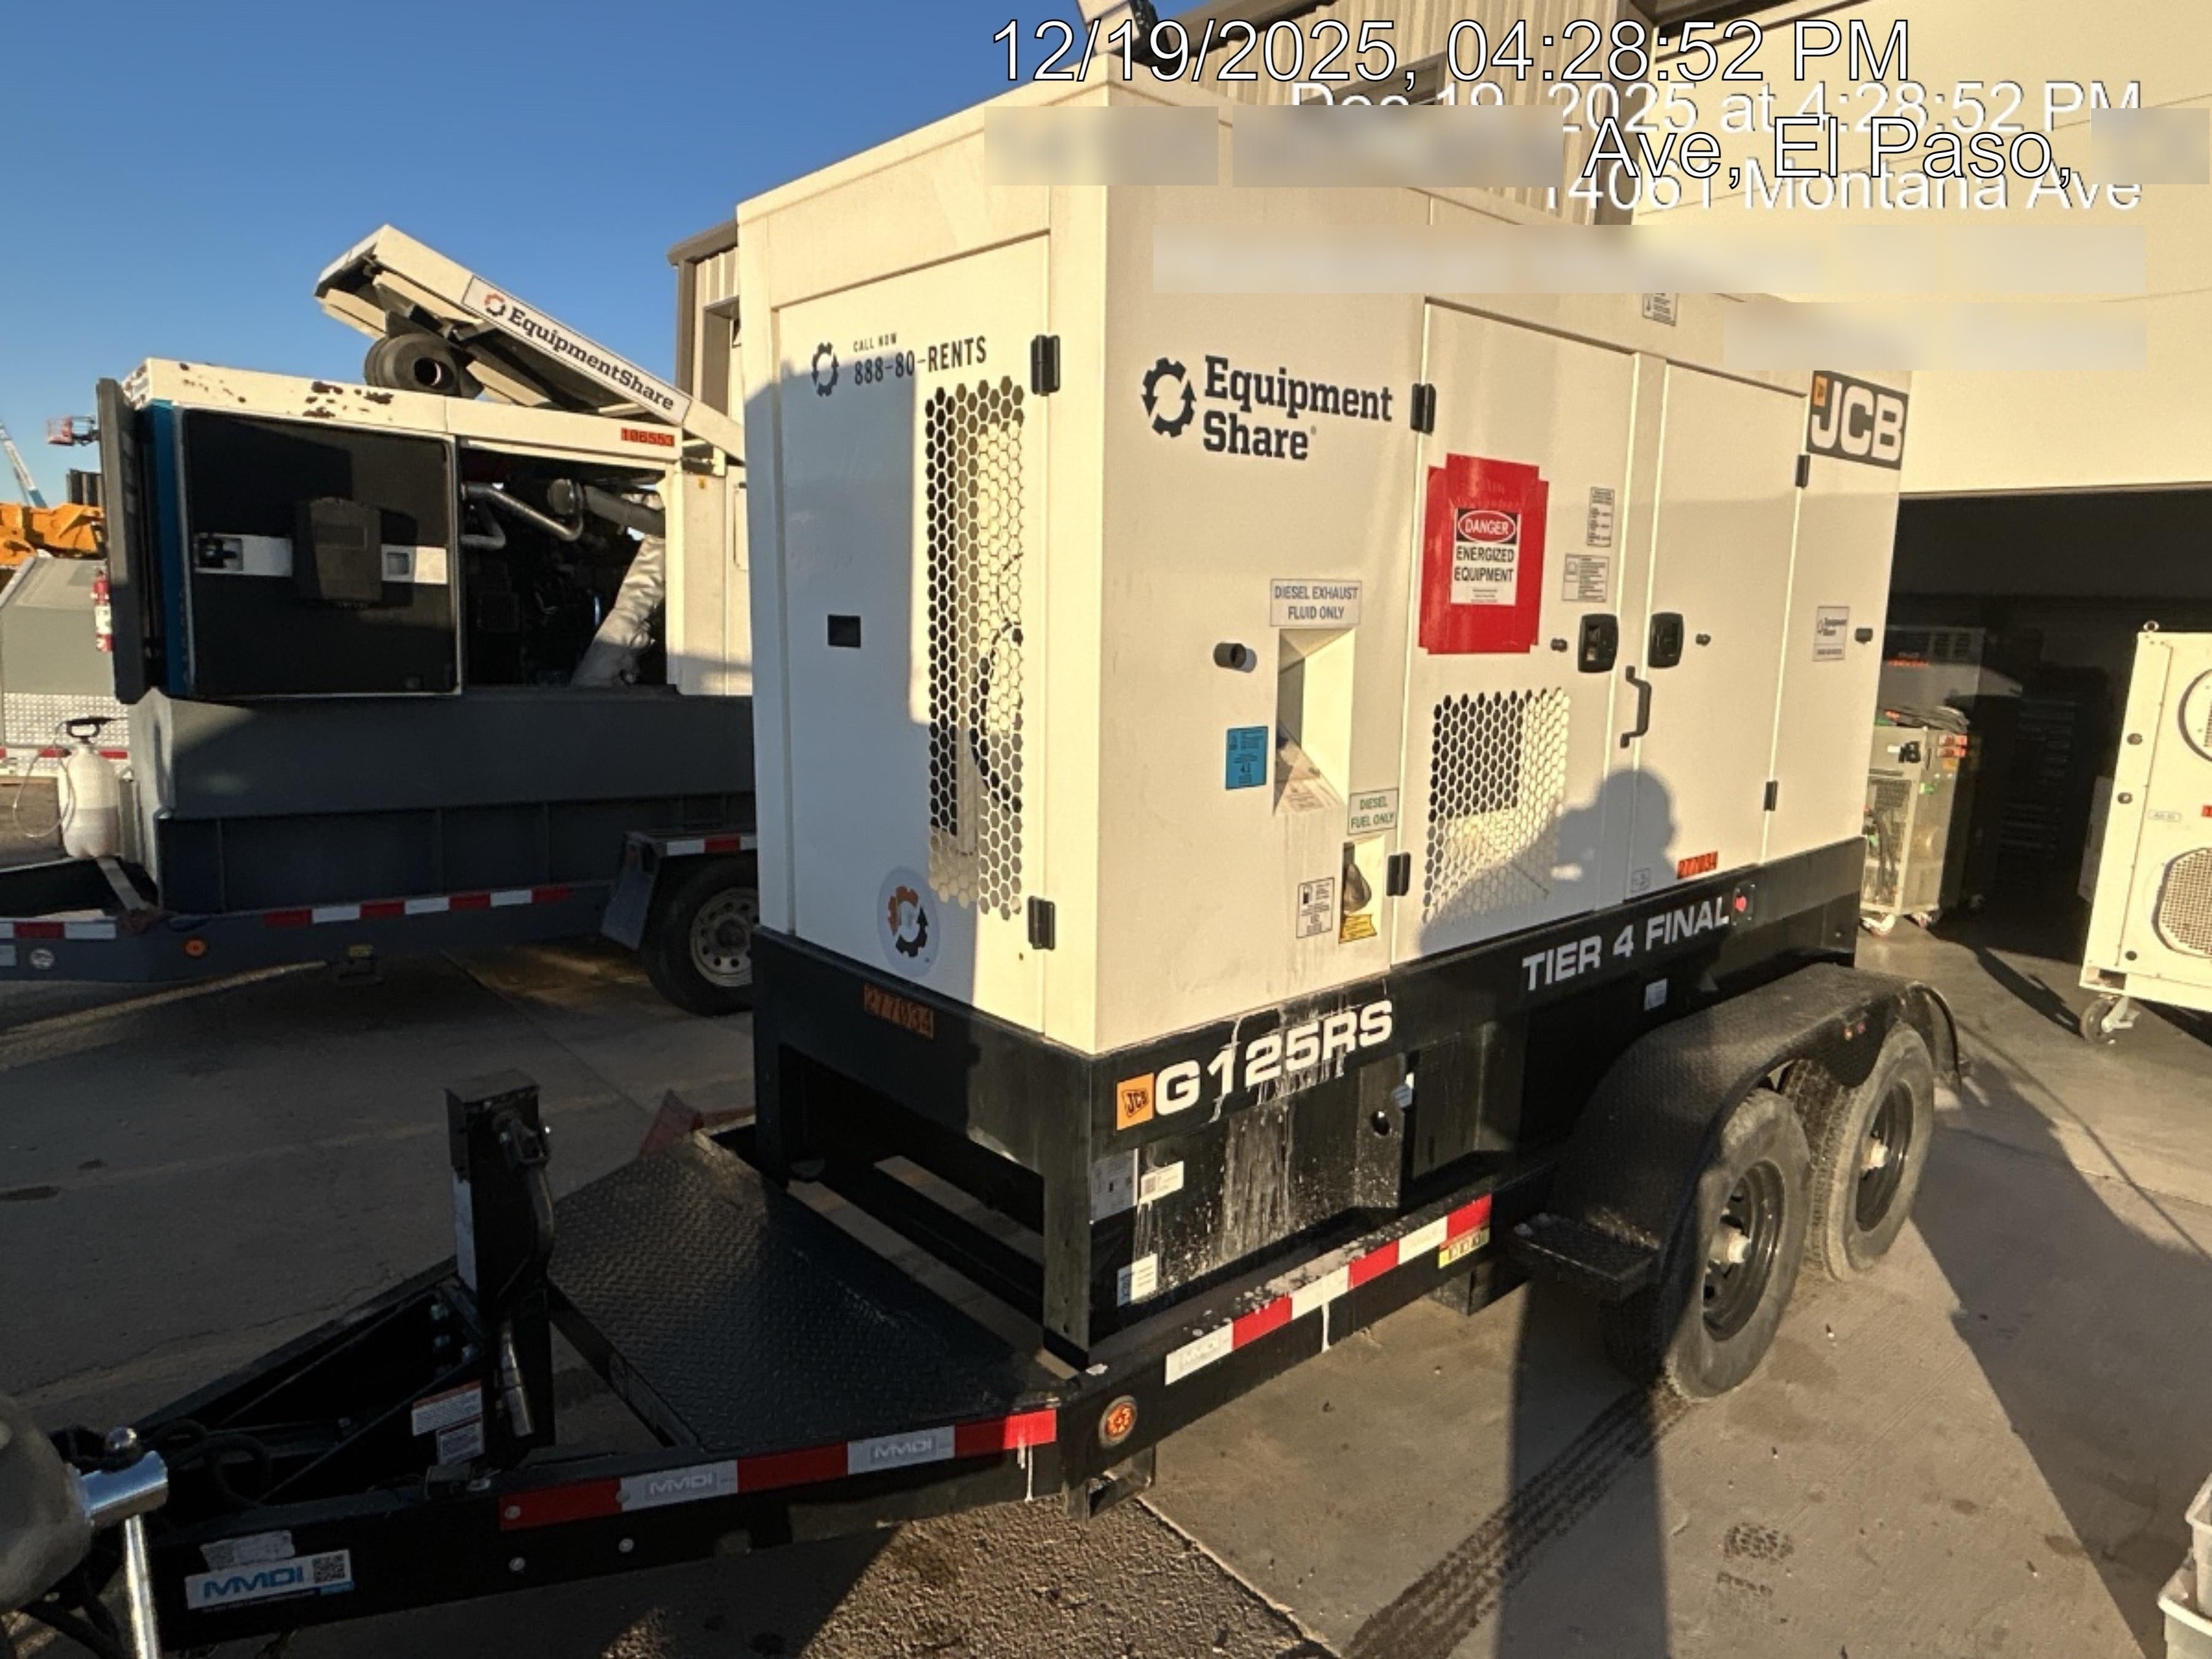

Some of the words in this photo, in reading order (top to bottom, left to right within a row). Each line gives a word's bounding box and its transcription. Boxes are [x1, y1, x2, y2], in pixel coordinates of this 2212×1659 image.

[853, 339, 875, 353] CALL
[876, 332, 898, 348] NOW
[508, 305, 674, 410] EquipmentShare
[854, 335, 987, 386] 888-80-RENTS
[1204, 354, 1393, 422] Equipment
[1811, 380, 1904, 461] JCB
[1464, 518, 1509, 535] DANGER
[1456, 546, 1515, 563] ENERGIZED
[1454, 565, 1514, 582] EQUIPMENT
[1274, 586, 1310, 600] DIESEL
[1312, 586, 1359, 600] EXHAUST
[1288, 606, 1317, 620] FLUID
[1319, 606, 1344, 620] ONLY
[1359, 796, 1389, 810] DIESEL
[1351, 815, 1371, 829] FUEL
[1373, 812, 1395, 825] ONLY
[1522, 935, 1602, 991] TIER
[1612, 924, 1634, 958] 4
[1645, 896, 1730, 951] FINAL
[1155, 1000, 1392, 1116] G125RS
[204, 1566, 304, 1599] MMDI
